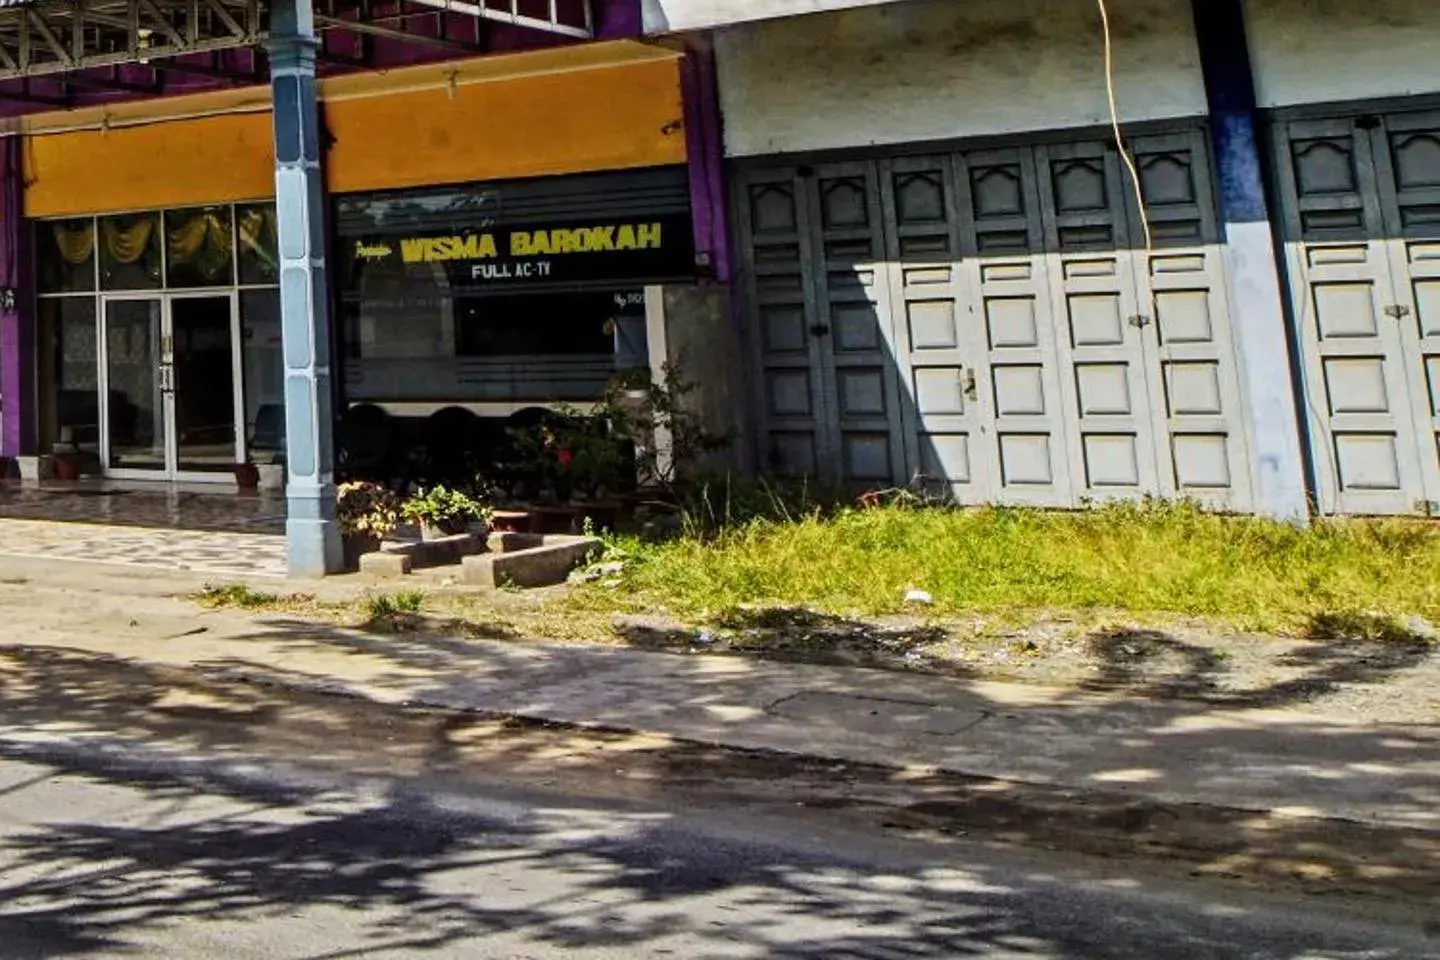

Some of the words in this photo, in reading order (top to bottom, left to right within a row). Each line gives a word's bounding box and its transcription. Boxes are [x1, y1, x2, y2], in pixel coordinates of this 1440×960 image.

[400, 234, 498, 262] WISMA
[510, 222, 661, 256] BAROKAH
[471, 263, 512, 279] FULL
[515, 261, 551, 277] AC-TV
